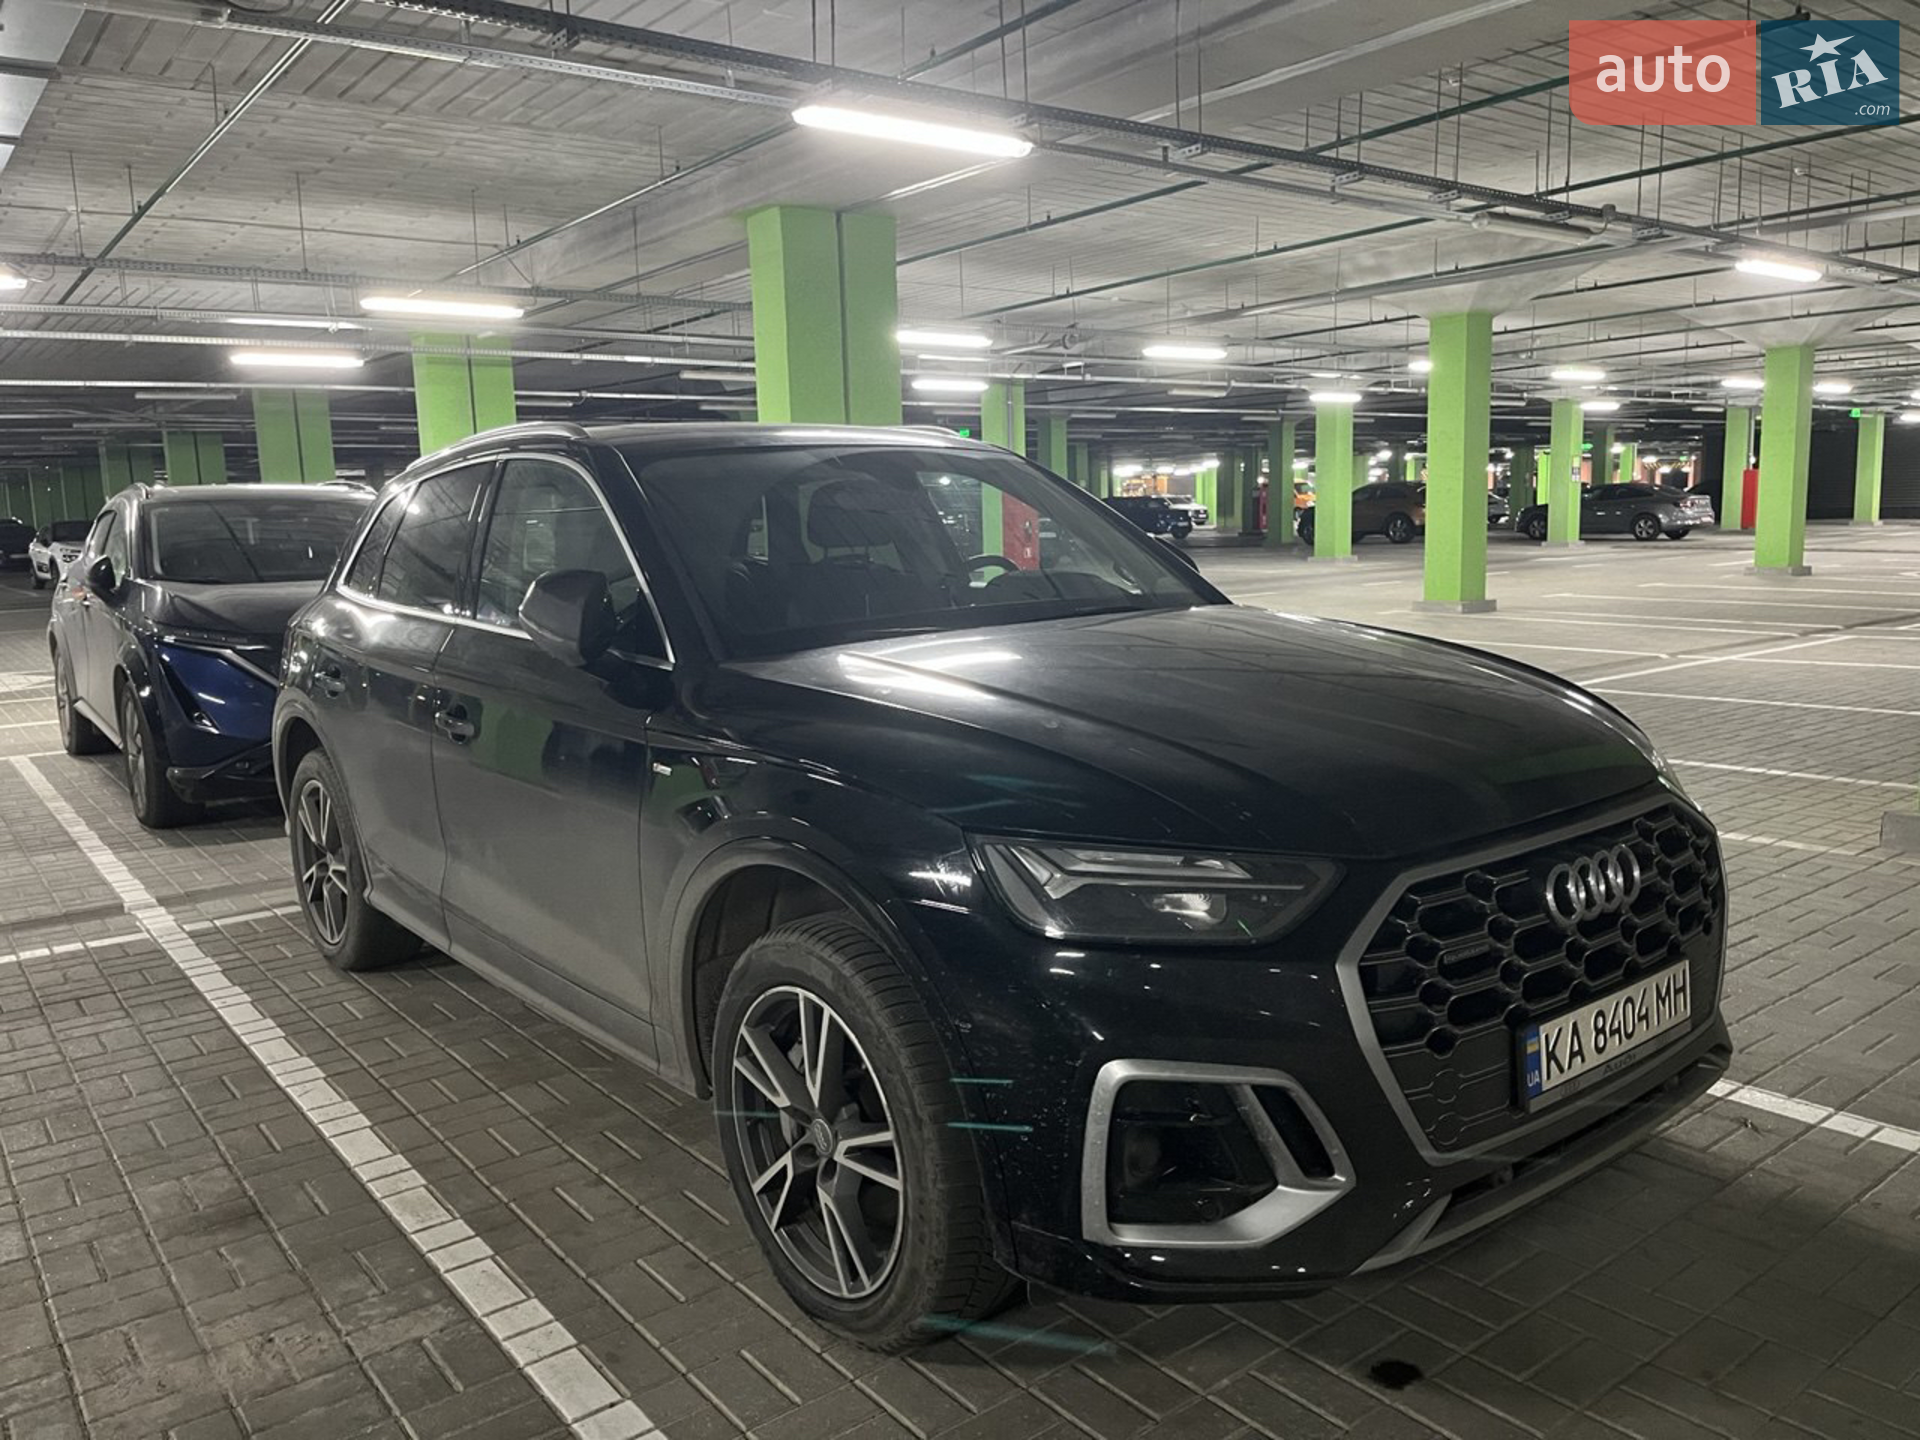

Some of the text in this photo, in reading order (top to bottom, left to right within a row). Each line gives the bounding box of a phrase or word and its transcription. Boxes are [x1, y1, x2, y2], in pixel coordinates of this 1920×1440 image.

[1543, 967, 1688, 1081] KA 8404 MH
[1526, 1069, 1541, 1088] UA
